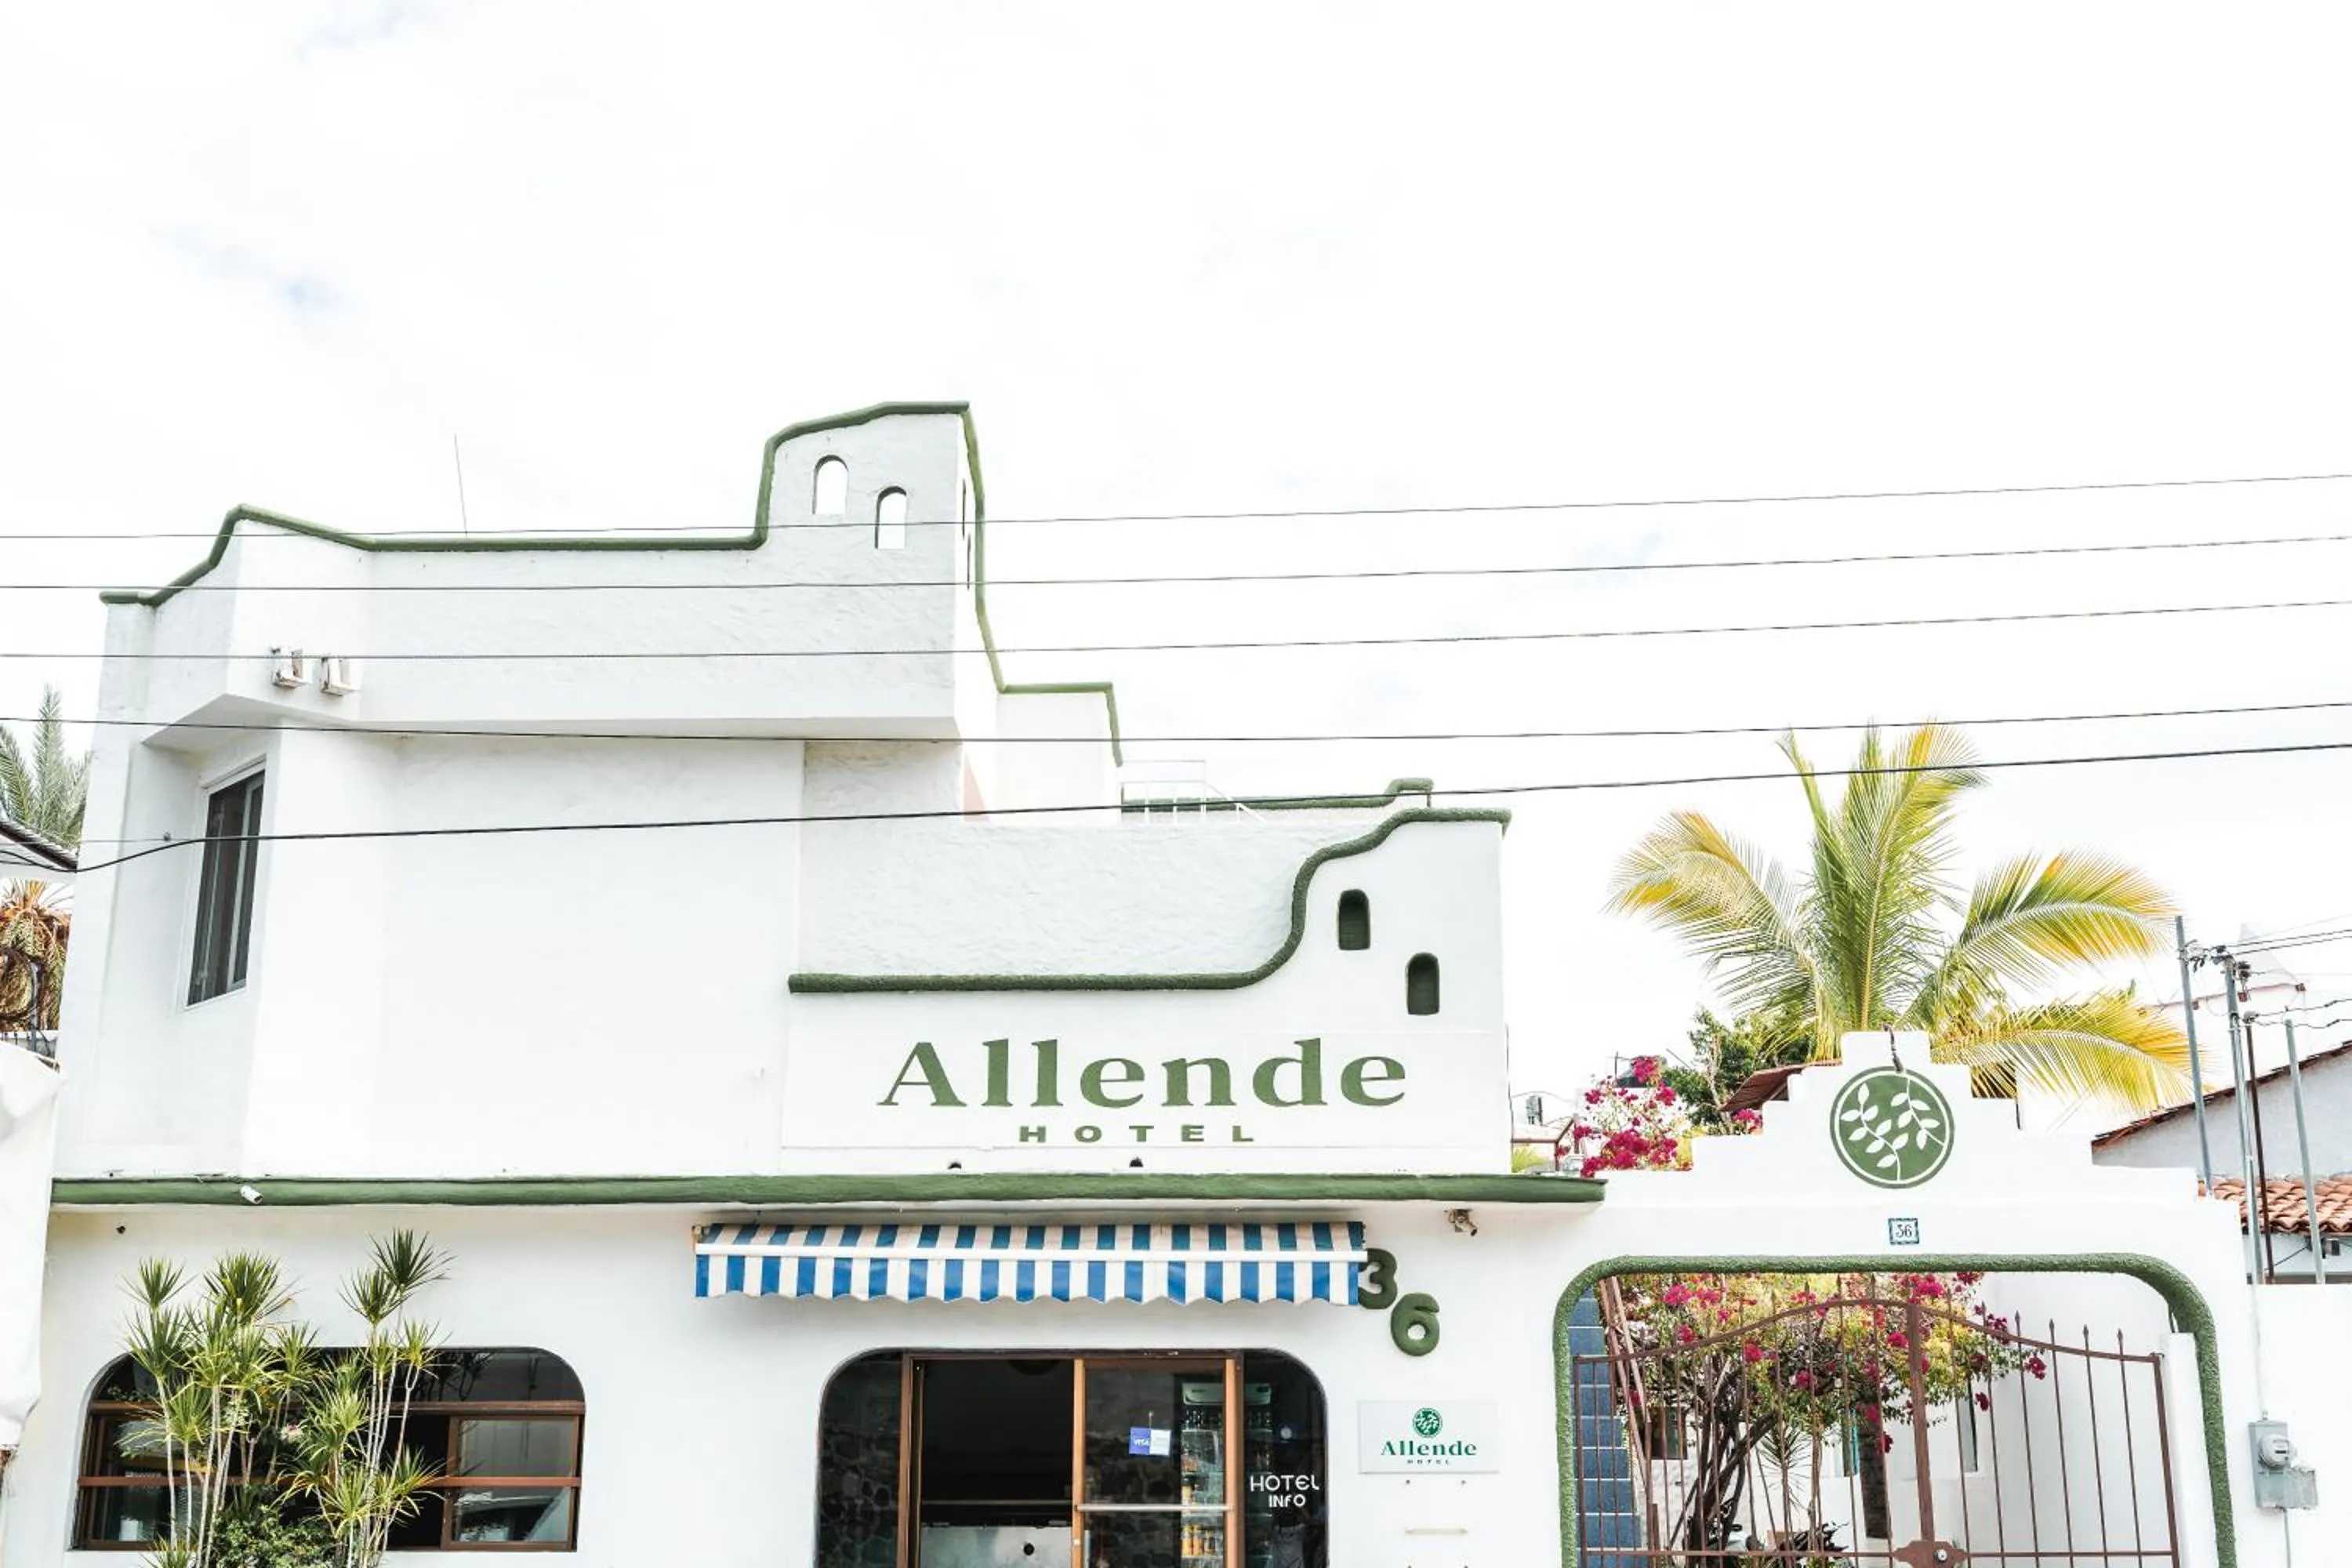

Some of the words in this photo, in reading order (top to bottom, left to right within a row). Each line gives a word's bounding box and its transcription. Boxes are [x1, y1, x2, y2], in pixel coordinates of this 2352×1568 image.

[877, 1037, 1406, 1108] Allende
[1018, 1124, 1254, 1143] HOTEL
[1896, 1224, 1912, 1238] 36
[1381, 1440, 1477, 1457] Allende
[1250, 1474, 1319, 1492] HOTEL
[1269, 1494, 1306, 1508] INFO
